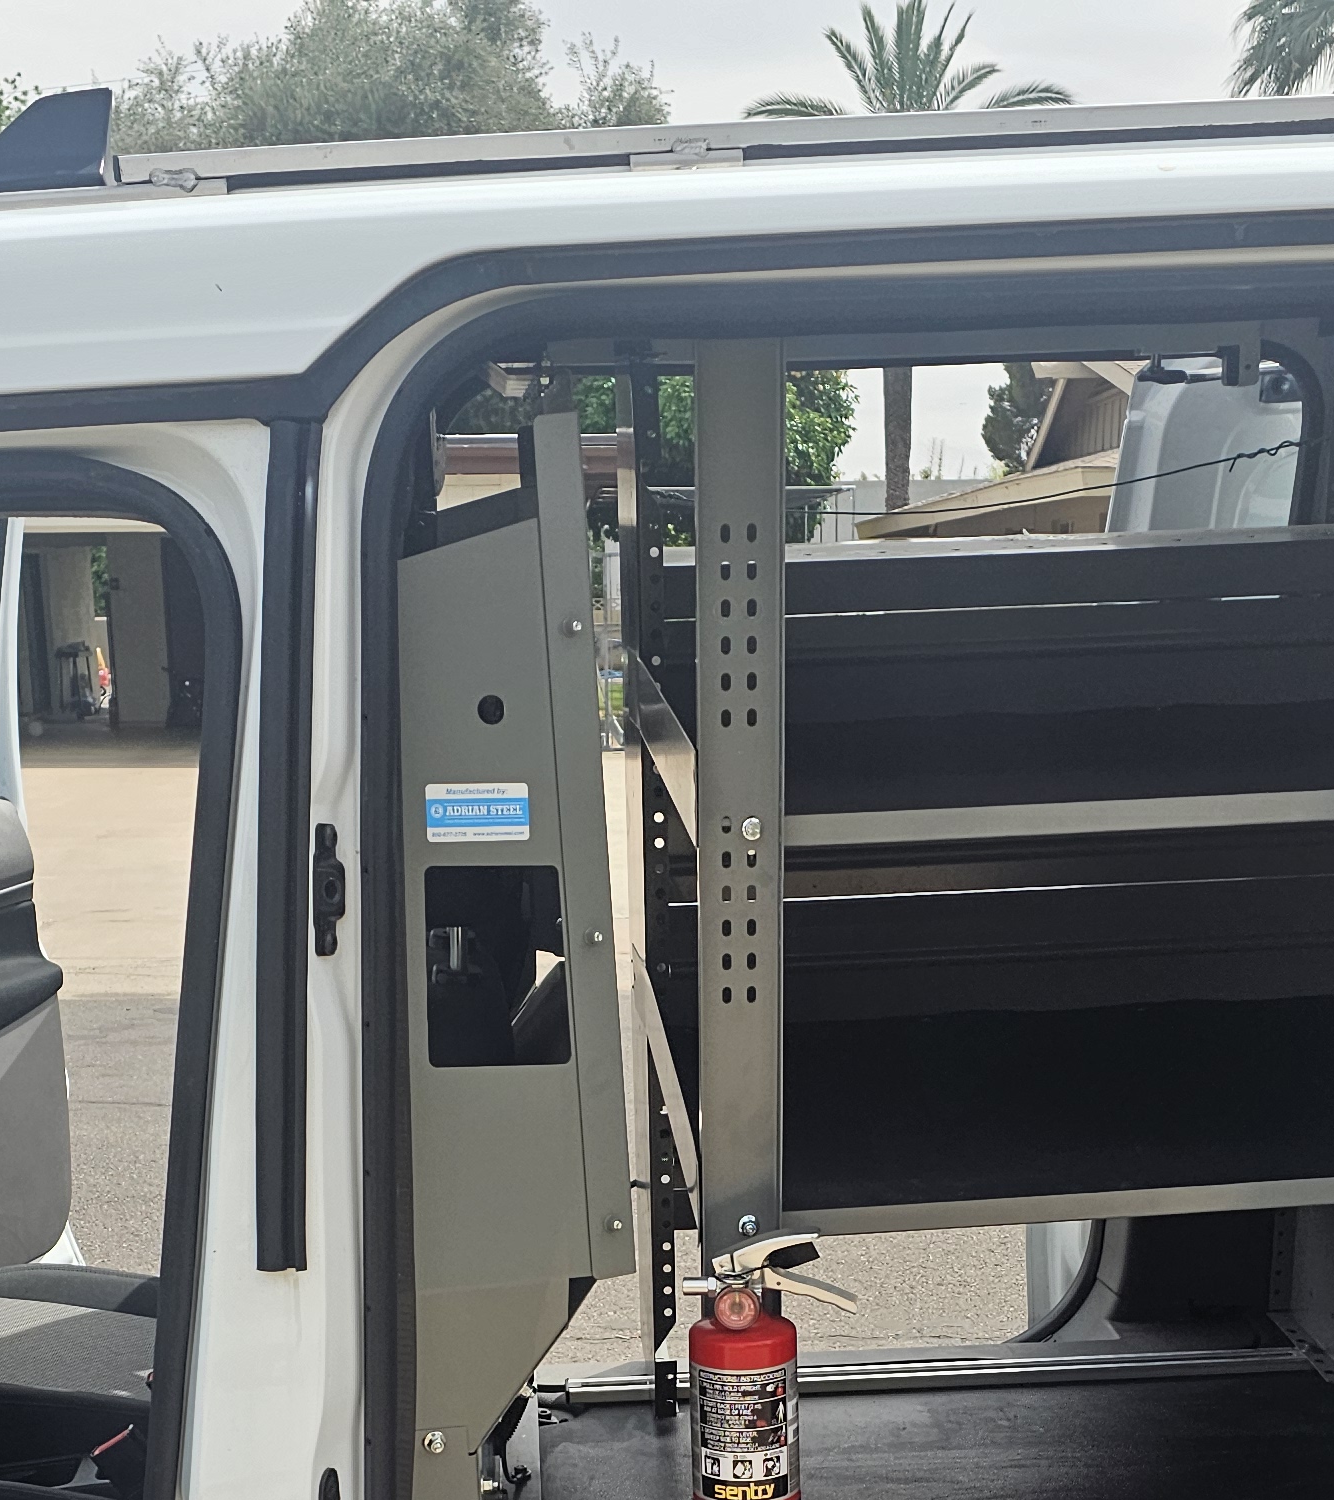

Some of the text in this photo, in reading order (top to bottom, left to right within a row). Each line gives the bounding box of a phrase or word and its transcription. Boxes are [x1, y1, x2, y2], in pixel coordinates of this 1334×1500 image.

[446, 804, 524, 816] ADRIAN STEEL
[714, 1483, 775, 1500] sentry
